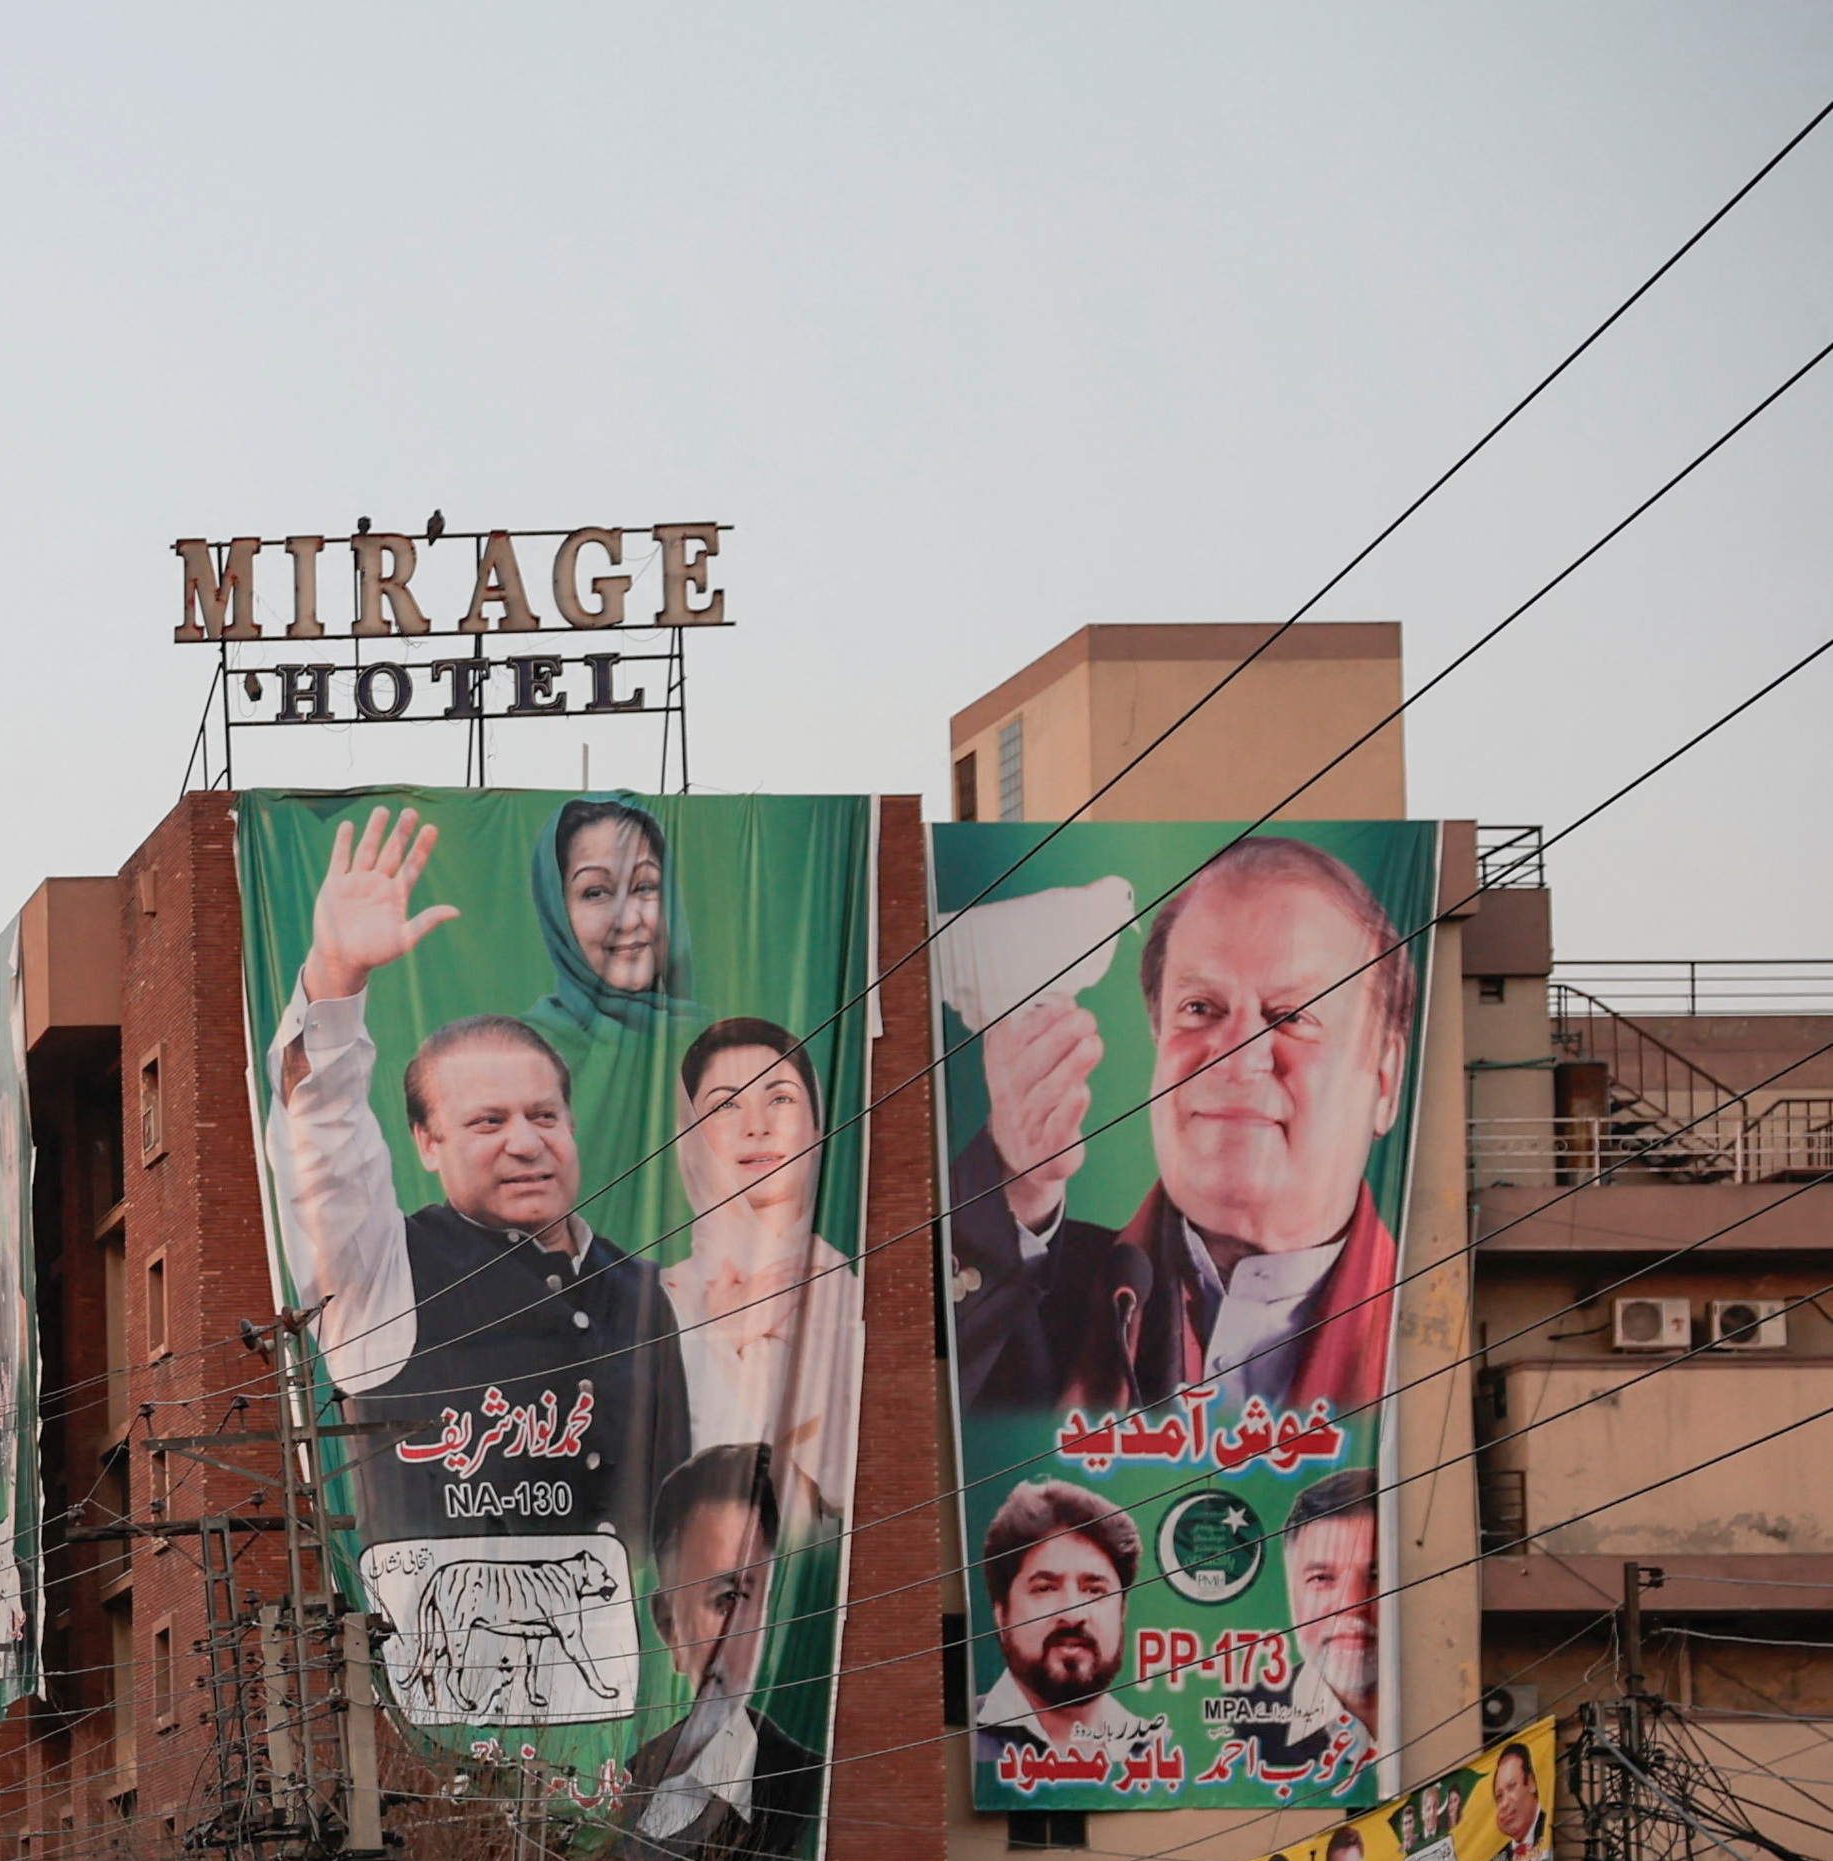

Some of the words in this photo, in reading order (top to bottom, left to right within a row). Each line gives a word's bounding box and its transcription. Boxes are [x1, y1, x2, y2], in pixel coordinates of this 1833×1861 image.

[173, 521, 727, 643] MIRAGE
[275, 652, 645, 722] HOTEL
[1055, 1384, 1218, 1472] آمدید
[1213, 1393, 1345, 1476] خوش
[444, 1481, 573, 1518] NA-130
[1135, 1627, 1289, 1693] PP-173
[1205, 1699, 1250, 1721] MPA
[997, 1741, 1111, 1792] محمود
[1111, 1737, 1185, 1792] بابر
